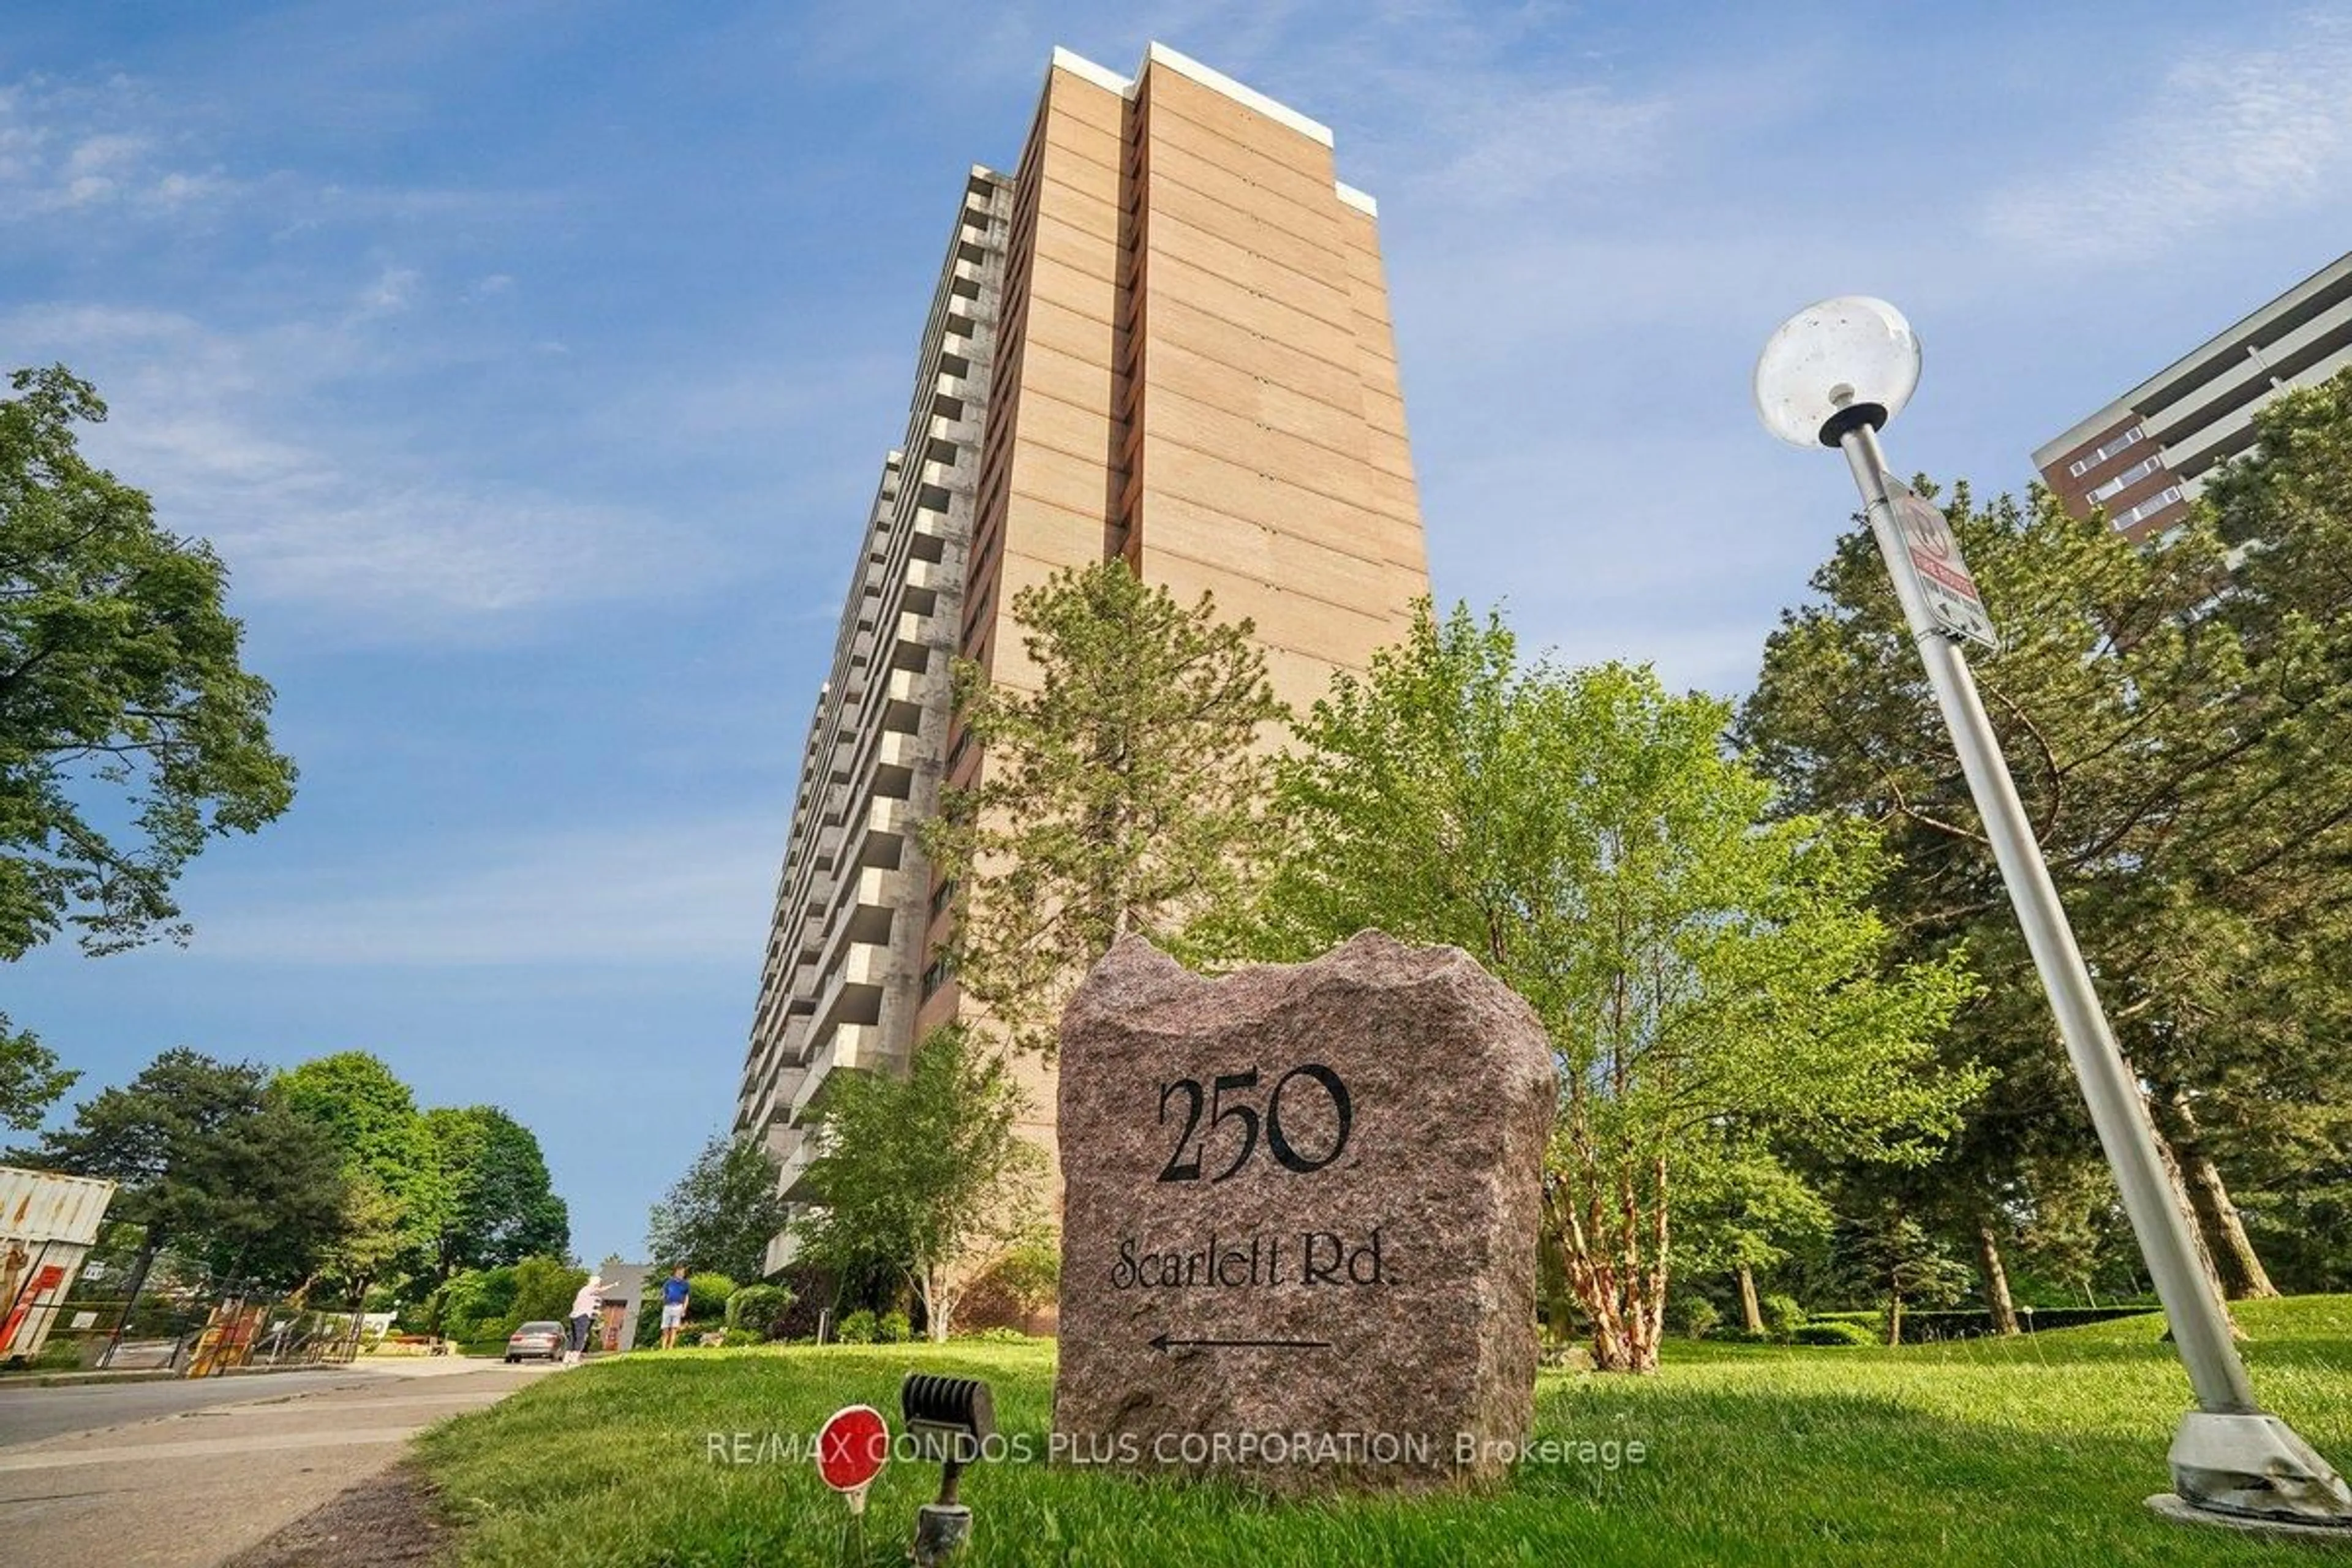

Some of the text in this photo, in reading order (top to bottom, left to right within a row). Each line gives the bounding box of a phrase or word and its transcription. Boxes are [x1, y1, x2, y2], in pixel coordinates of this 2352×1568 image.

[1156, 1063, 1352, 1183] 250
[1110, 1227, 1400, 1291] Scarlett Rd.
